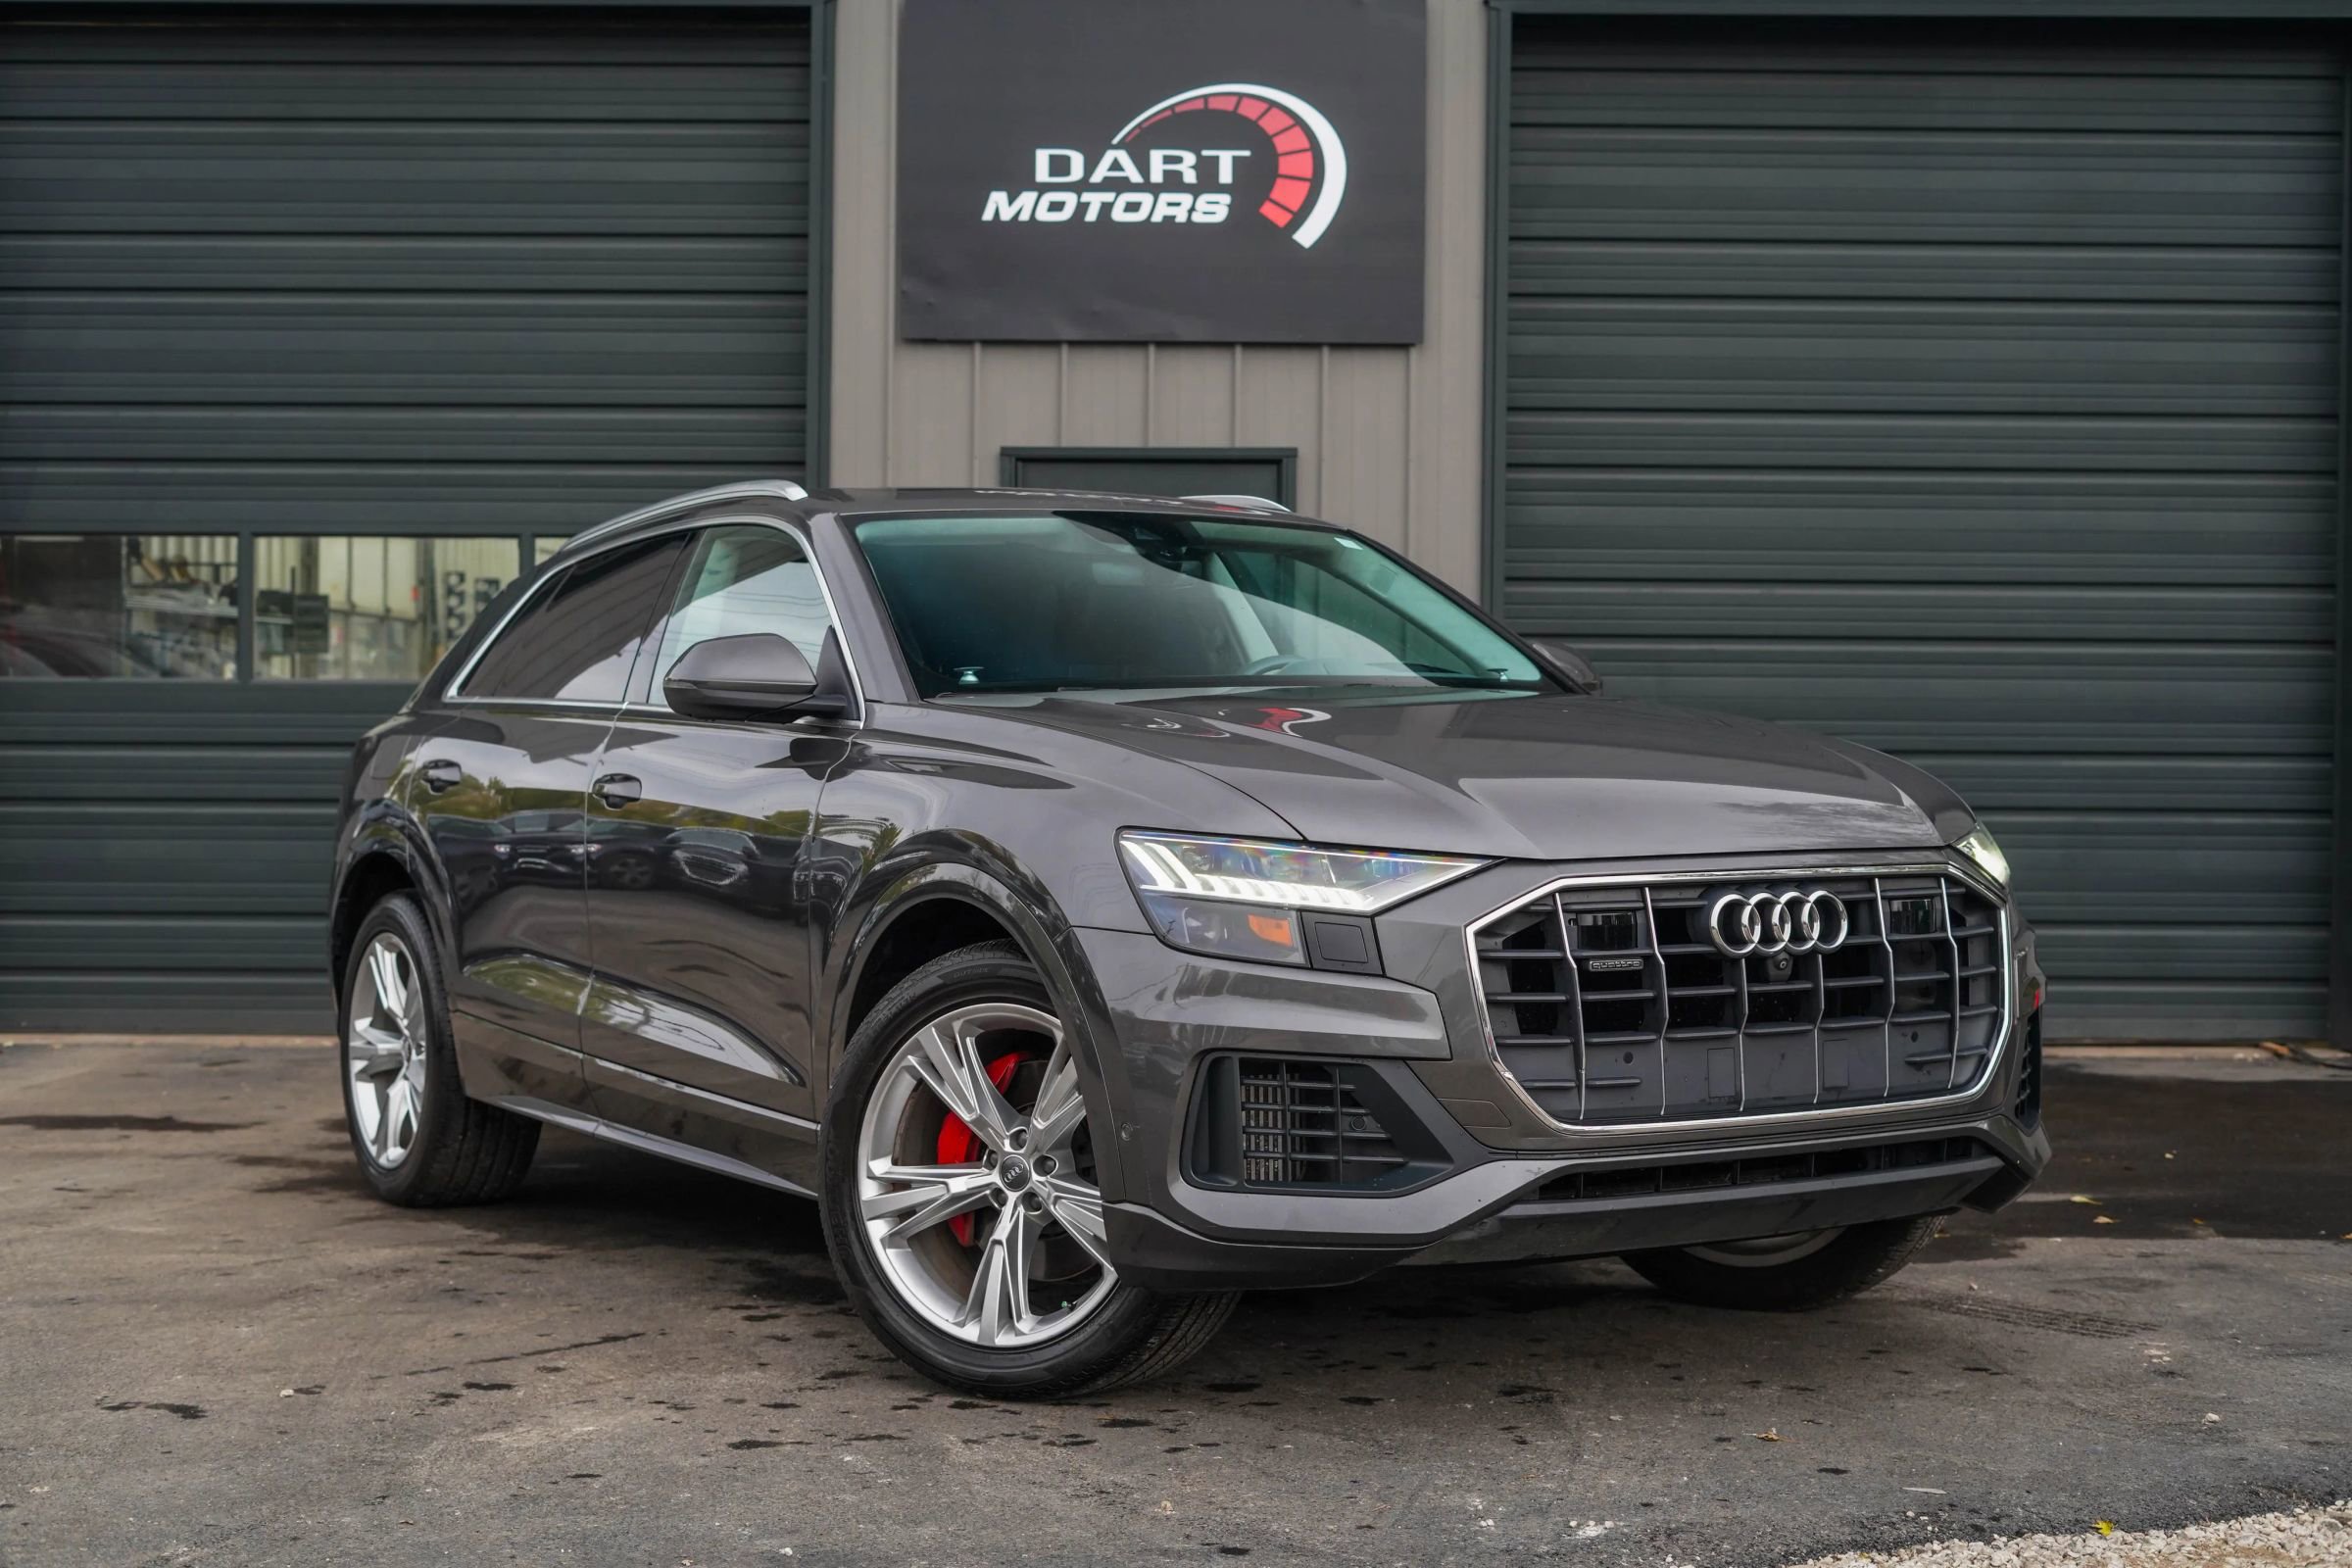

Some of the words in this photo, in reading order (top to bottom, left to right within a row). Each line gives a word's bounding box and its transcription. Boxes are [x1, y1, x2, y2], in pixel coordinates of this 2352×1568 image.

[1035, 148, 1251, 184] DART
[981, 190, 1232, 223] MOTORS
[1592, 960, 1642, 970] quattro
